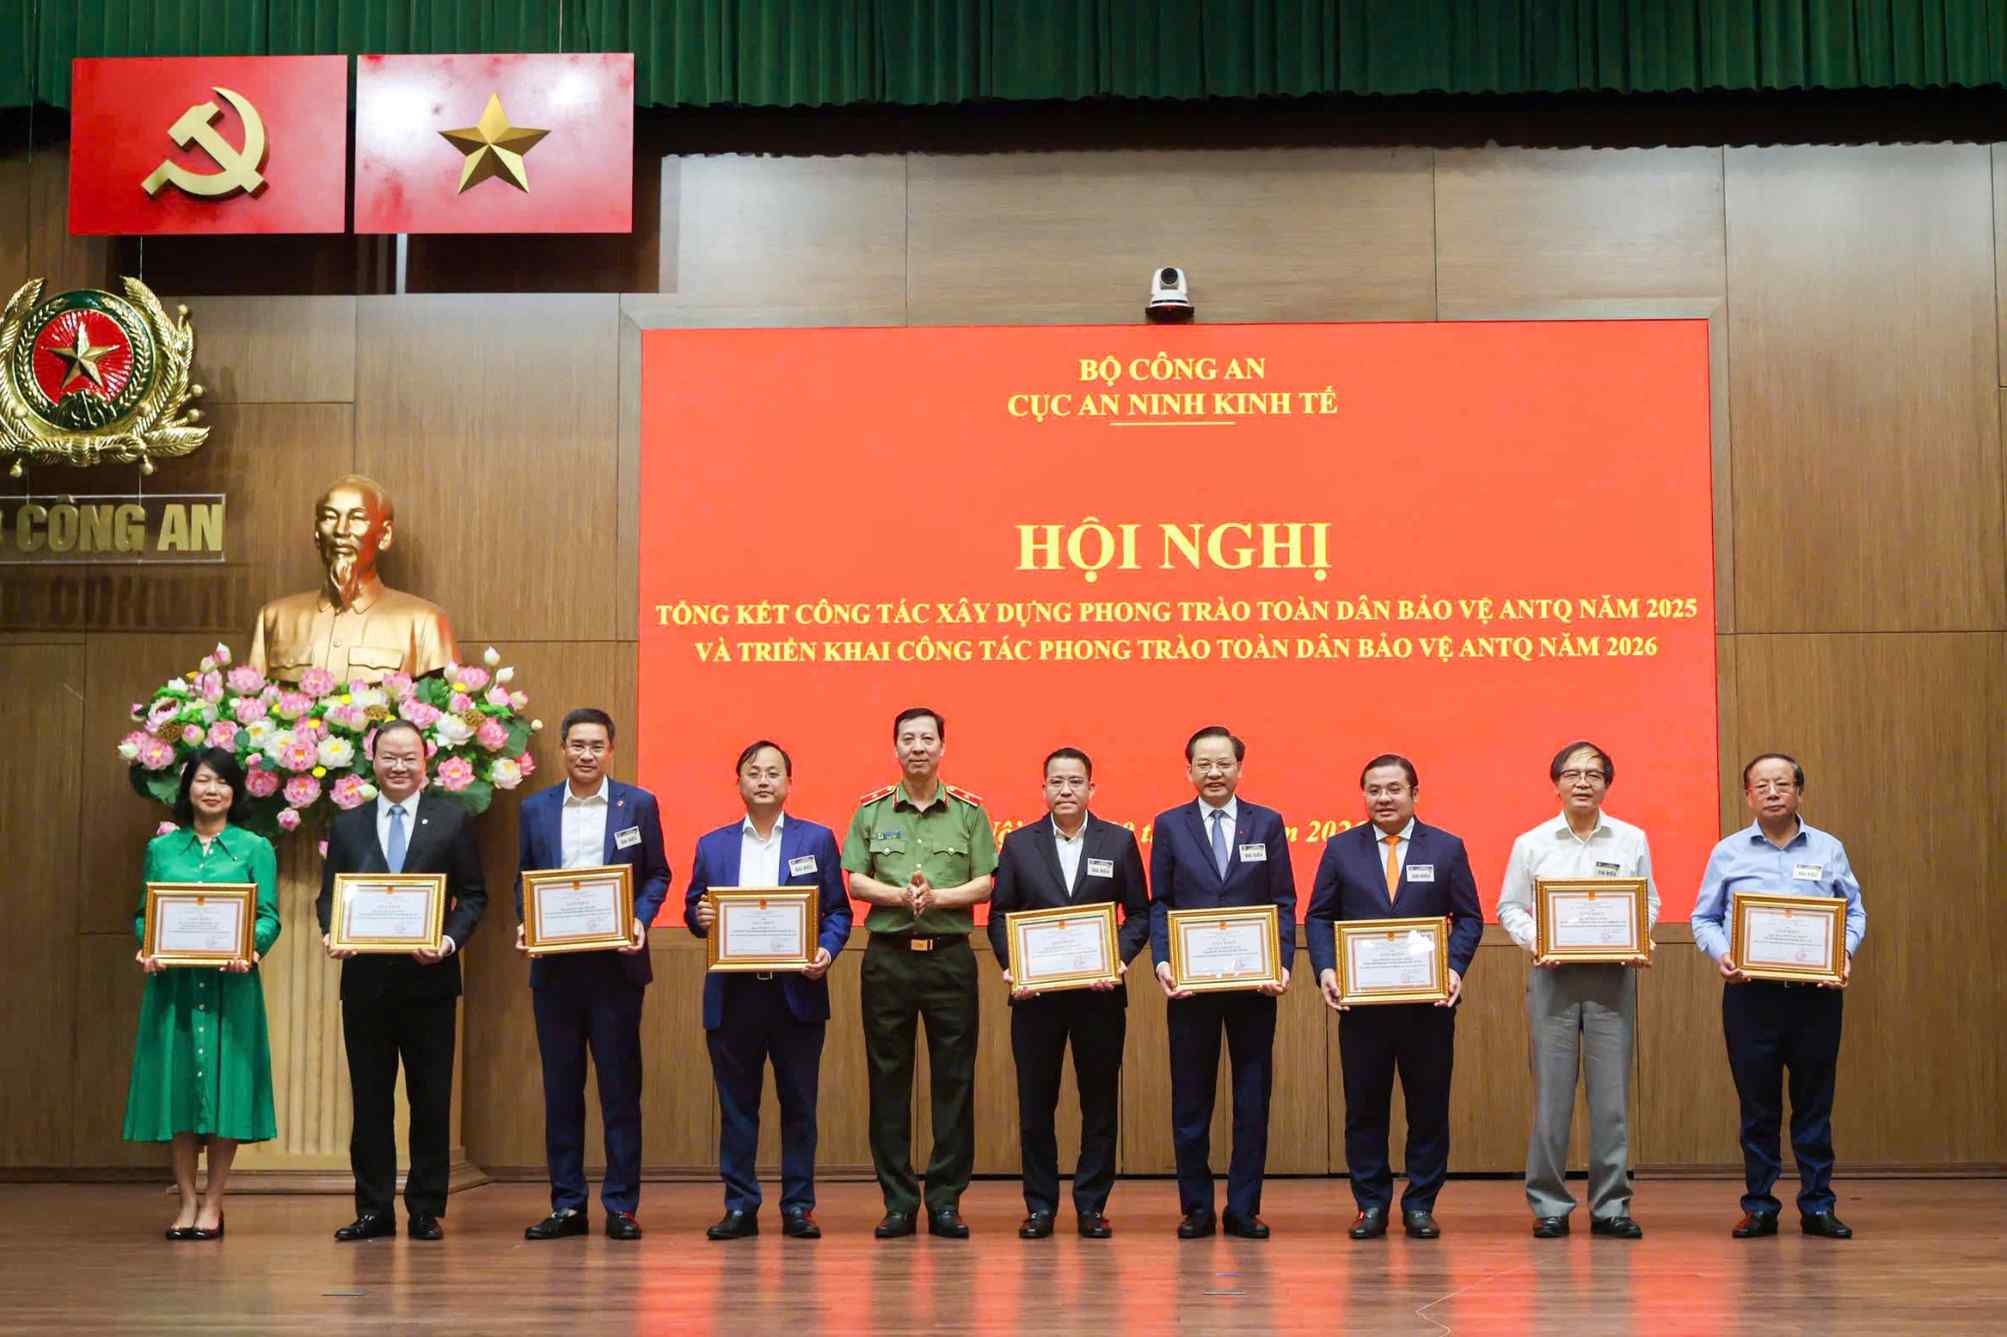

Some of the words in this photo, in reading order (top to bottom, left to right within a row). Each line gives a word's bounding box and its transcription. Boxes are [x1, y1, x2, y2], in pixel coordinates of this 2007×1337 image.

[1079, 354, 1121, 386] BỘ
[1128, 351, 1217, 381] CÔNG
[1223, 357, 1265, 380] AN
[1007, 393, 1072, 422] CỤC
[1078, 393, 1120, 416] AN
[1128, 392, 1205, 415] NINH
[1214, 391, 1292, 415] KINH
[1299, 385, 1338, 414] TẾ
[15, 496, 147, 554] CÔNG
[157, 503, 224, 552] AN
[1015, 516, 1142, 583] HỘI
[1158, 522, 1332, 582] NGHỊ
[655, 598, 730, 625] TỔNG
[735, 599, 791, 625] KẾT
[795, 597, 871, 625] CÔNG
[876, 597, 930, 624] TÁC
[936, 597, 991, 624] XÂY
[997, 599, 1072, 628] DỰNG
[1079, 600, 1172, 623] PHONG
[1177, 596, 1251, 622] TRÀO
[1257, 595, 1329, 622] TOÀN
[1336, 594, 1391, 621] DÂN
[1397, 593, 1453, 621] BẢO
[1458, 597, 1494, 625] VỆ
[1498, 598, 1573, 624] ANTQ
[1578, 594, 1640, 619] NĂM
[1646, 597, 1698, 619] 2025
[694, 636, 732, 662] VÀ
[736, 635, 817, 662] TRIỂN
[823, 639, 891, 662] KHAI
[896, 634, 973, 662] CÔNG
[978, 635, 1032, 661] TÁC
[1039, 639, 1132, 661] PHONG
[1136, 633, 1211, 660] TRÀO
[1216, 633, 1289, 660] TOÀN
[1295, 632, 1350, 659] DÂN
[1357, 632, 1413, 659] BẢO
[1418, 635, 1454, 663] VỆ
[1459, 636, 1534, 662] ANTQ
[1538, 632, 1600, 657] NĂM
[1606, 636, 1659, 657] 2026
[1305, 820, 1368, 843] 202
